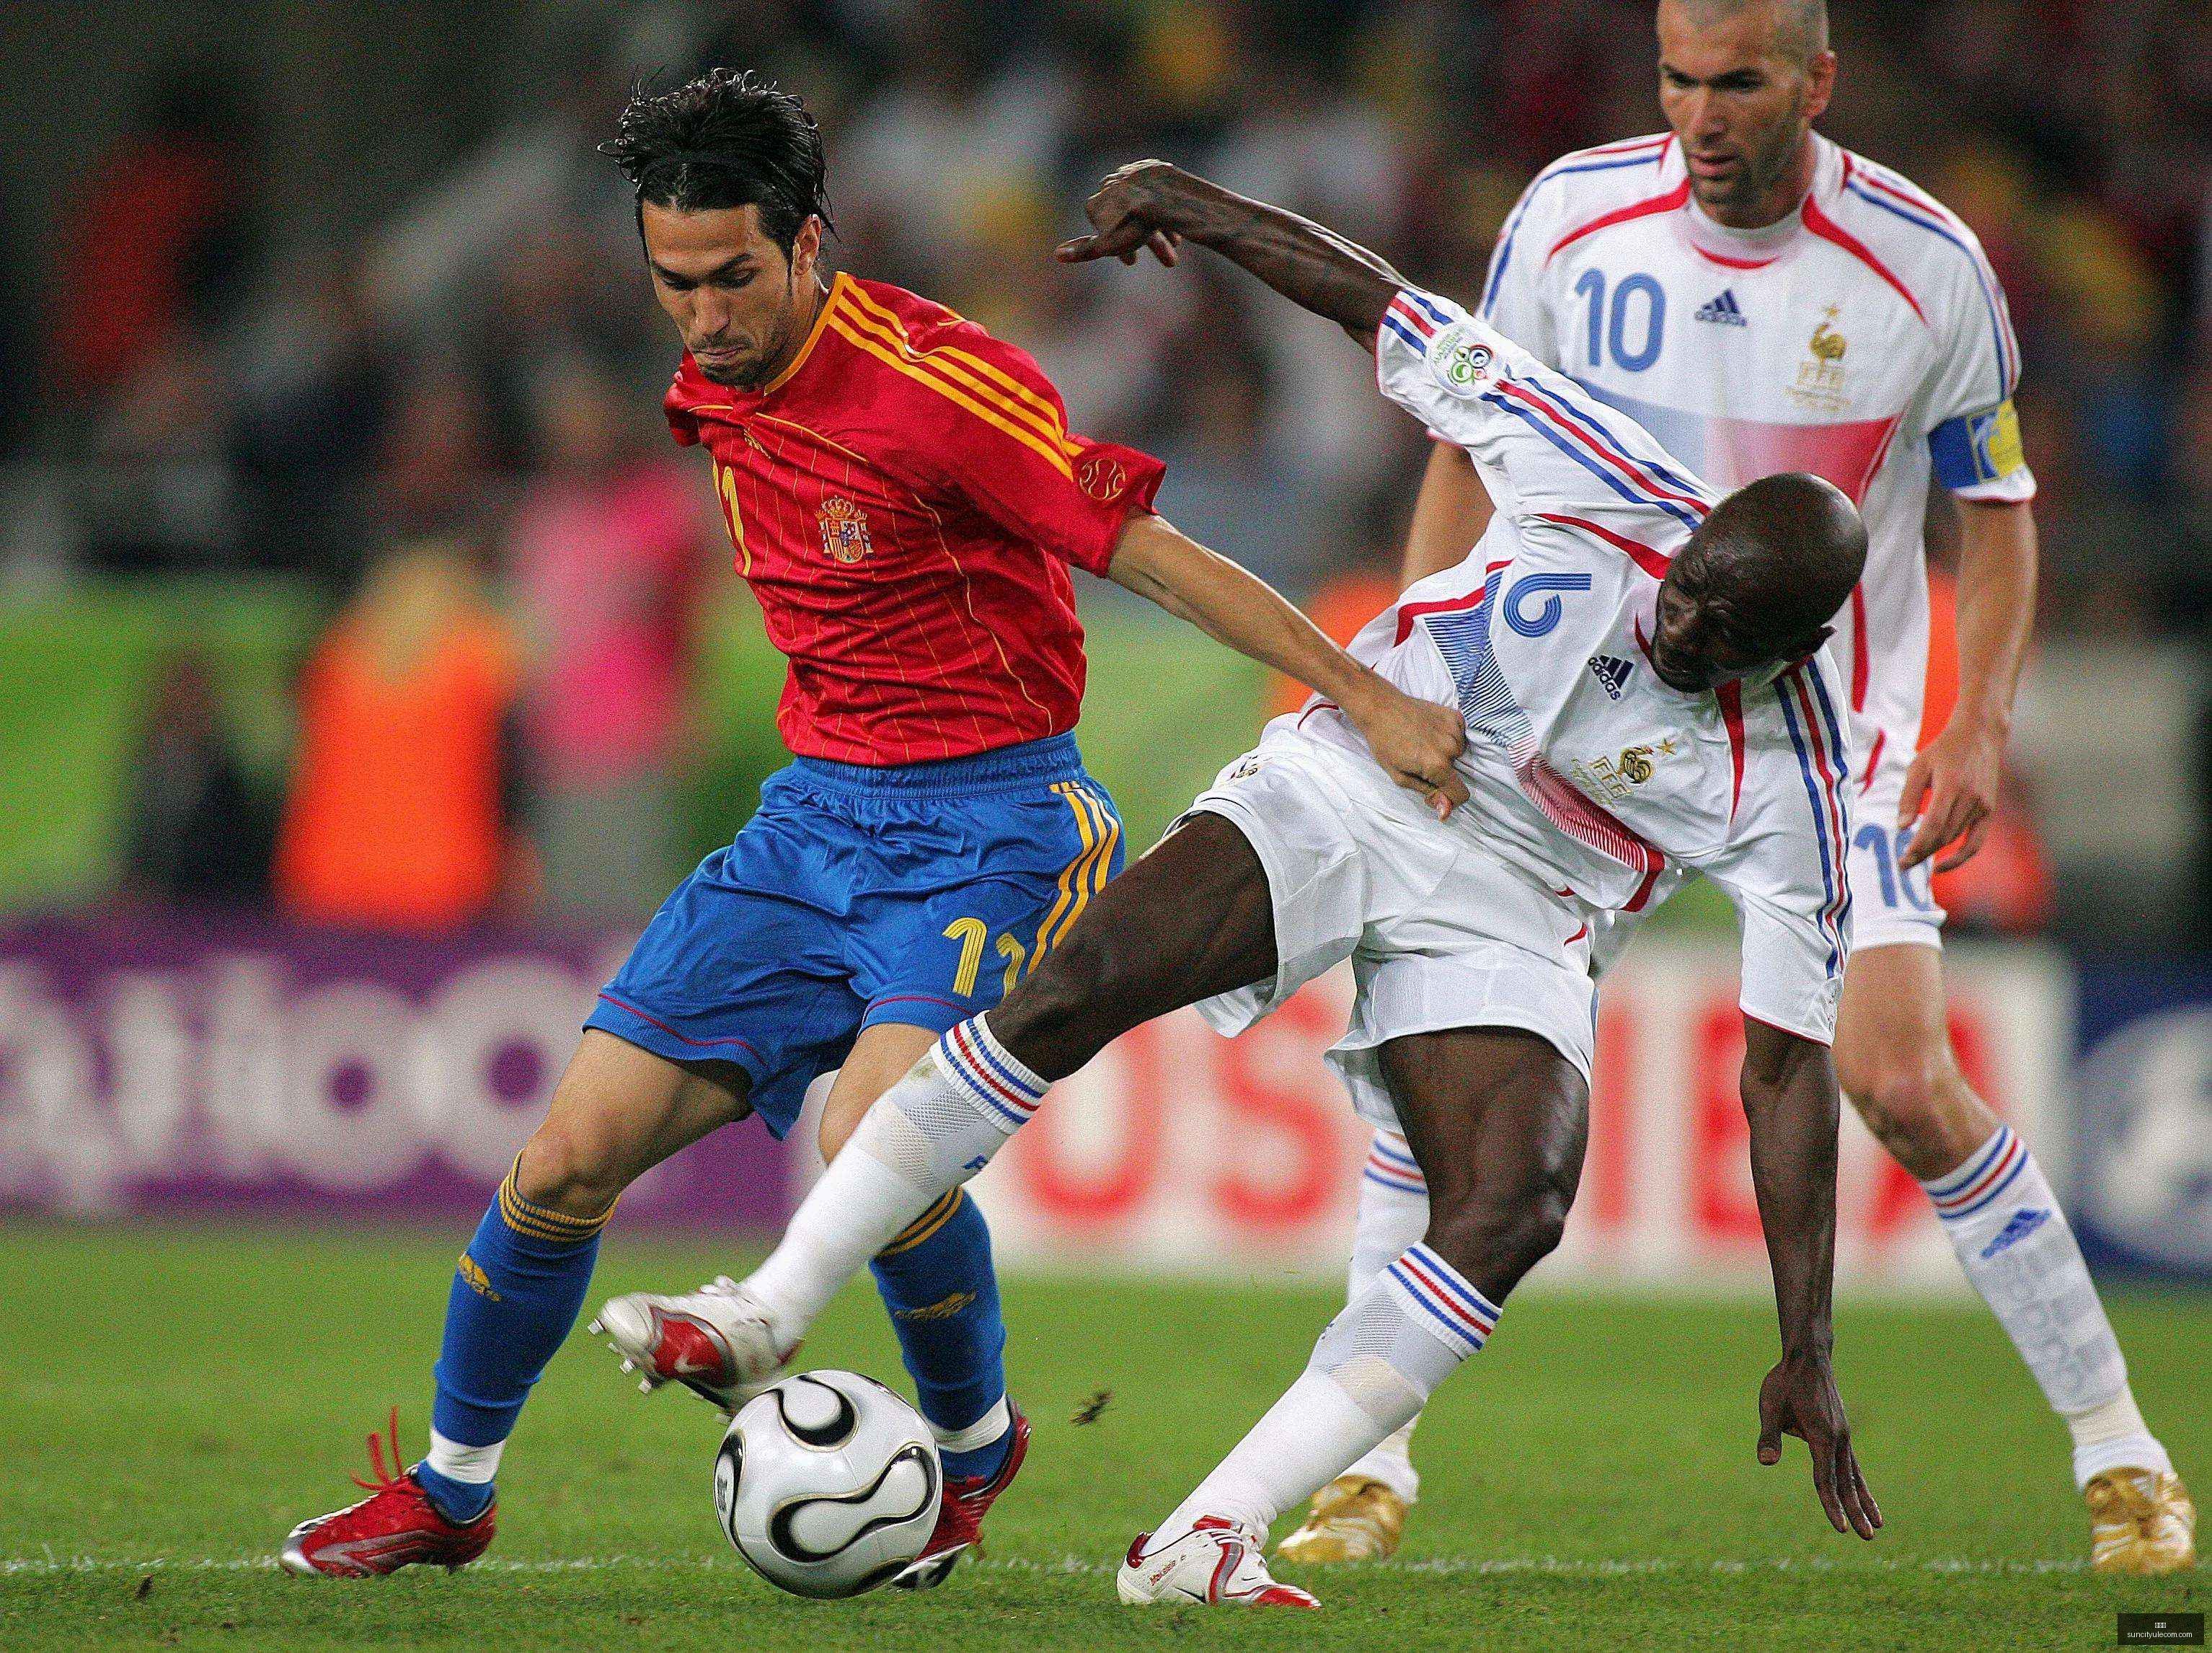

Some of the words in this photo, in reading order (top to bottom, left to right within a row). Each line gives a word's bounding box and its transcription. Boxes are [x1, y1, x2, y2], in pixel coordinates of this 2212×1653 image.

[1575, 268, 1666, 372] 10
[1503, 573, 1592, 638] 6
[1588, 656, 1621, 700] adidas
[1853, 823, 1933, 911] 10
[942, 917, 1025, 1001] 11
